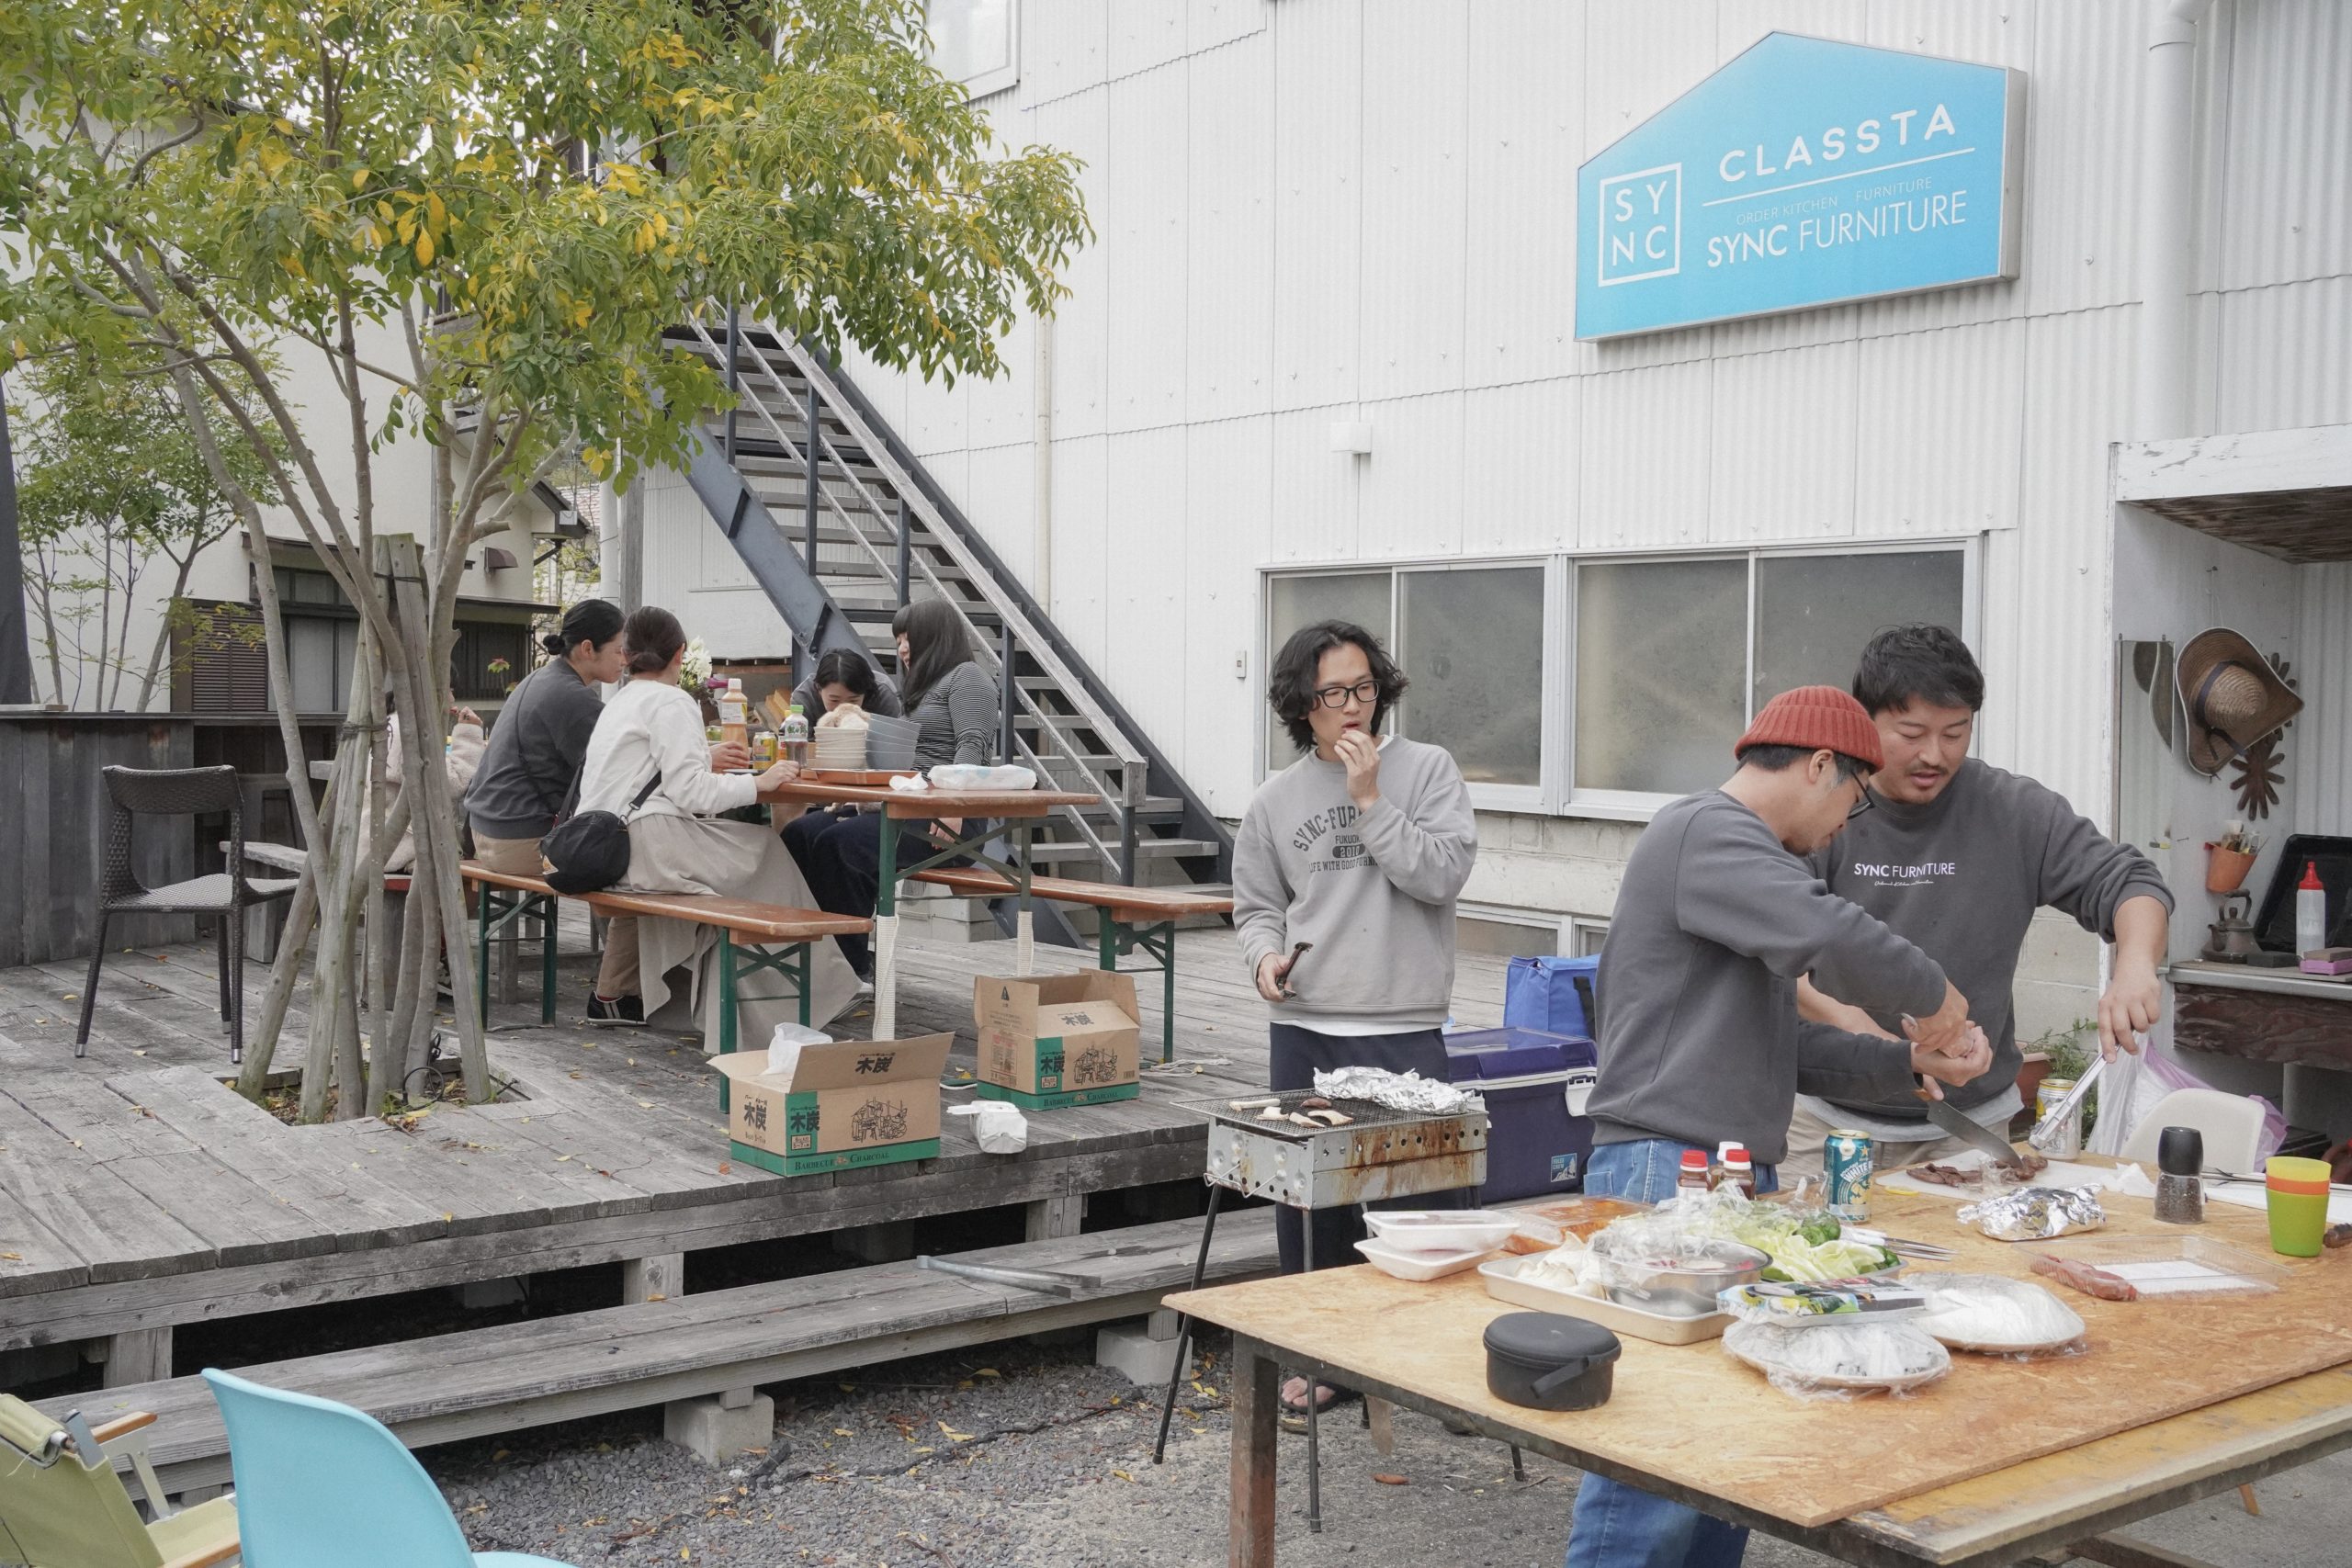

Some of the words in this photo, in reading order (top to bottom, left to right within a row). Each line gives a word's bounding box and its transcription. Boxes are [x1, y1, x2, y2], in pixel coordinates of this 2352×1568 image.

[1719, 103, 1955, 182] CLASSTA
[1736, 206, 1779, 226] ORDER
[1782, 196, 1838, 217] KITCHEN
[1855, 176, 1932, 202] FURNITURE
[1707, 224, 1788, 268] SYNC
[1799, 190, 1967, 252] FURNITURE
[1293, 806, 1363, 852] SYNC-FUR
[1335, 834, 1363, 845] FUKUOK
[1340, 845, 1361, 858] 2010
[1308, 862, 1322, 874] LIFE
[1323, 860, 1341, 872] WITH
[1341, 859, 1356, 870] GOOD
[1355, 856, 1378, 868] FURNI
[1854, 863, 1890, 877] SYNC
[1892, 863, 1956, 878] FURNITURE
[1061, 1013, 1094, 1026] 木炭
[854, 1056, 893, 1075] 木炭
[1040, 1055, 1065, 1074] 木炭
[743, 1101, 767, 1133] 木炭
[790, 1110, 820, 1134] 木炭
[795, 1159, 833, 1171] BARBECUE
[850, 1152, 889, 1164] CHARCOAL
[1844, 1162, 1868, 1183] WHITE
